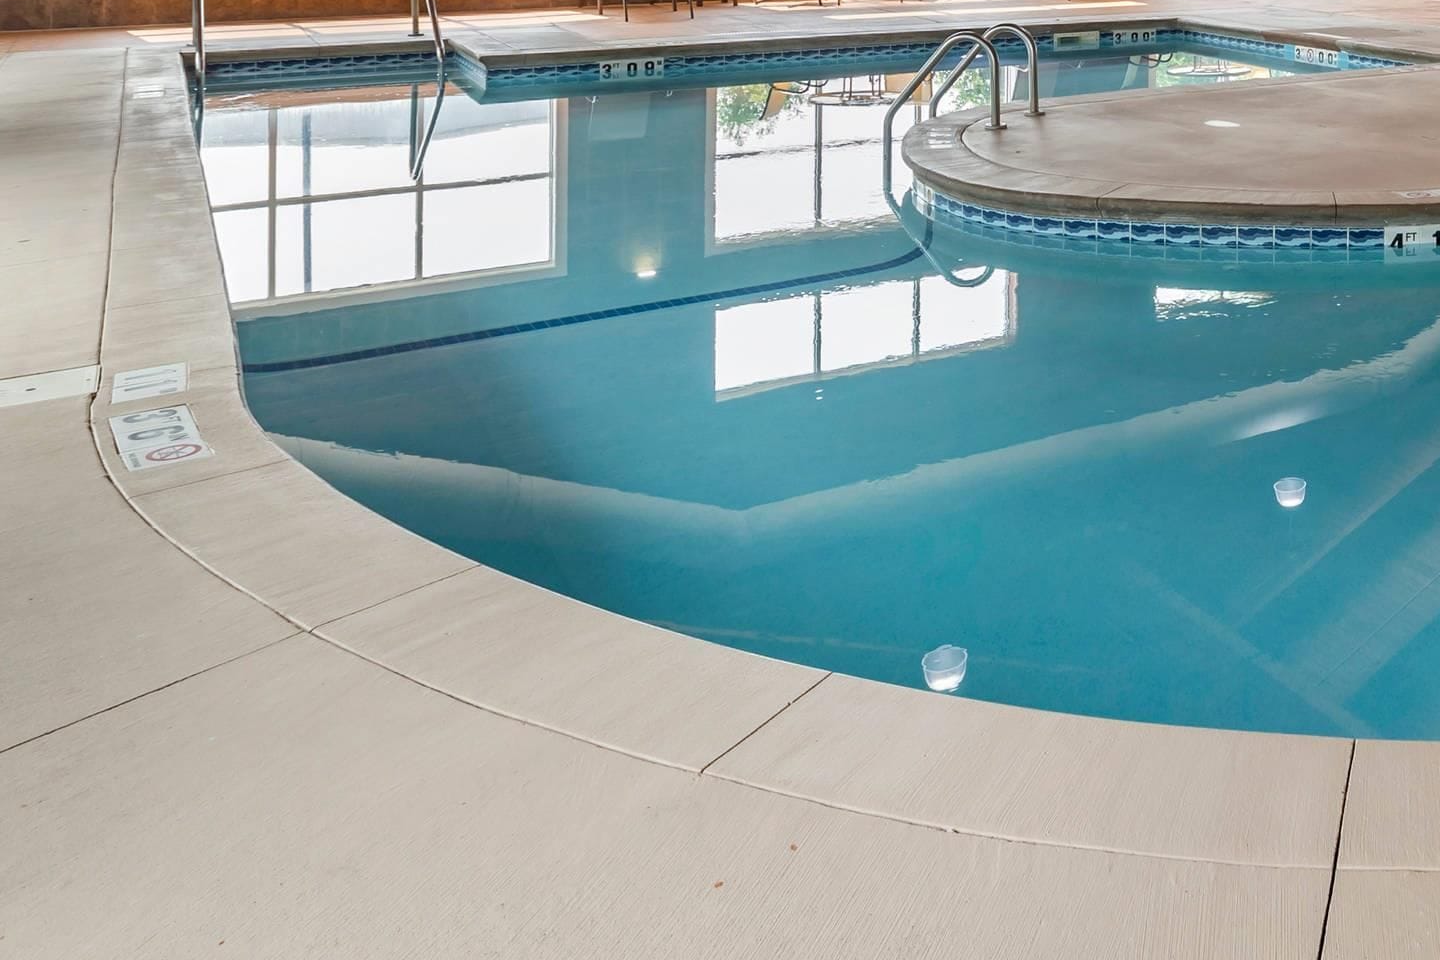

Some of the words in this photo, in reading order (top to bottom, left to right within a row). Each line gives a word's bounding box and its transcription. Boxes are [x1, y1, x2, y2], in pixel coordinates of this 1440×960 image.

[1295, 48, 1301, 59] 3
[602, 64, 612, 76] 3
[1388, 233, 1403, 248] 4
[1406, 233, 1417, 241] FT
[122, 409, 177, 423] 3
[127, 425, 184, 440] 6
